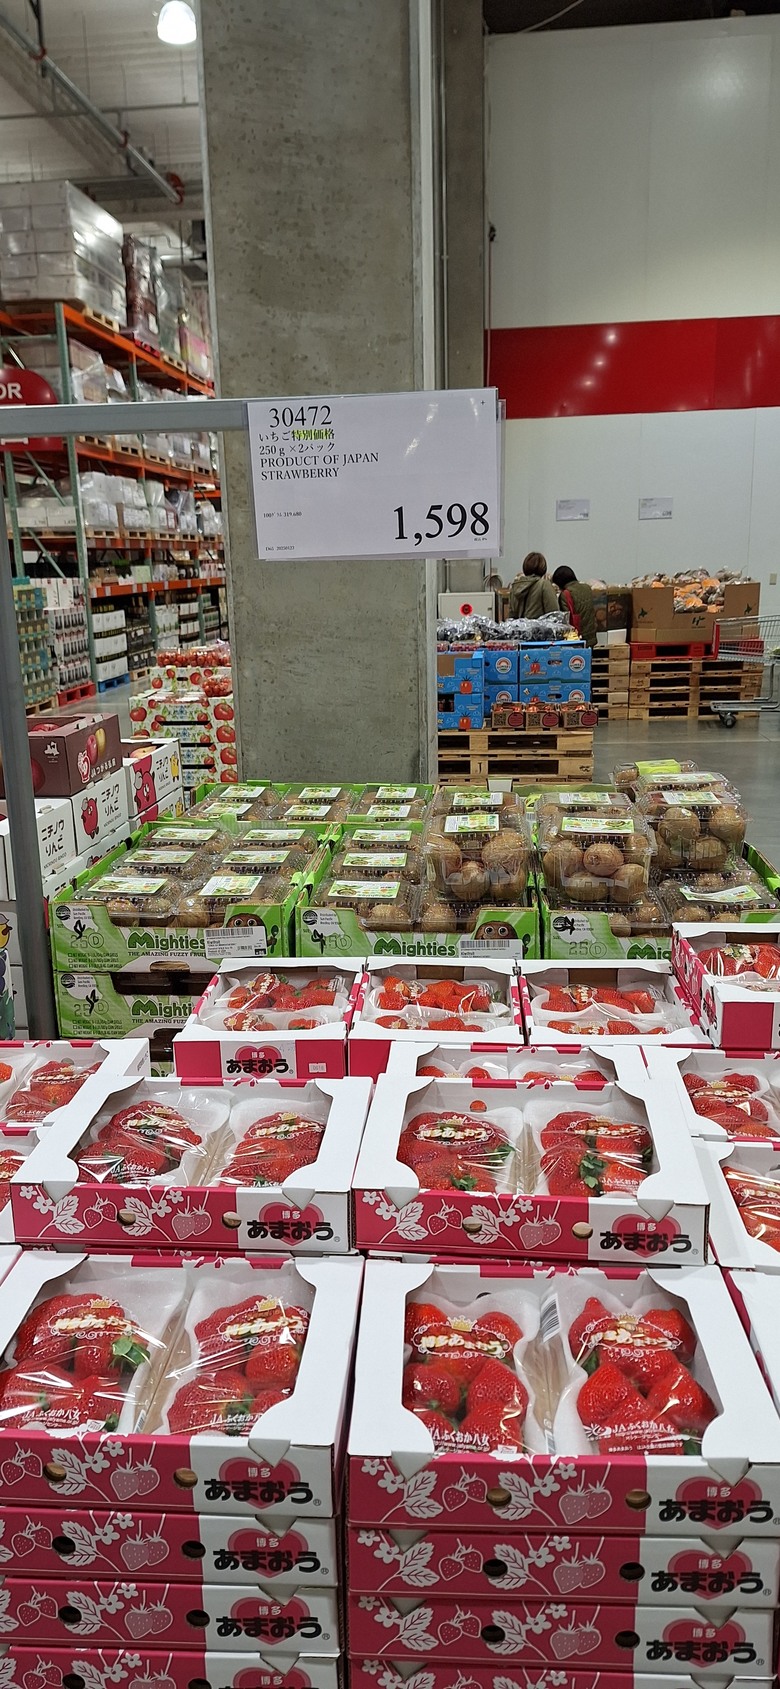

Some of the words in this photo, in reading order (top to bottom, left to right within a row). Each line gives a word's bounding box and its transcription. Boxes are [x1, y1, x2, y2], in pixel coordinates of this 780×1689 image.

[268, 405, 332, 428] 30472
[260, 428, 335, 441] いちご特別価格
[260, 445, 276, 456] 250
[260, 456, 320, 468] PRODUCT
[322, 454, 340, 465] OF
[342, 452, 378, 466] JAPAN
[261, 468, 340, 480] STRAWBERRY
[394, 502, 490, 546] 1,598
[101, 784, 120, 804] ニチノウ
[104, 799, 119, 816] りんご
[41, 819, 65, 842] ニチノウ
[45, 834, 64, 856] りんご
[128, 932, 205, 950] Mighties
[374, 938, 456, 957] Mighties
[226, 1058, 289, 1074] あまおう
[282, 1210, 302, 1219] 博多
[247, 1219, 334, 1241] あまおう
[636, 1222, 656, 1232] 博多
[600, 1231, 692, 1252] あまおう
[248, 1467, 271, 1478] 博多
[204, 1479, 313, 1504] あまおう
[706, 1486, 732, 1497] 博多
[658, 1499, 774, 1523] あまおう
[257, 1537, 280, 1548] 博多
[213, 1549, 320, 1572] あまおう
[698, 1559, 722, 1569] 博多
[651, 1570, 764, 1594] あまおう
[259, 1605, 282, 1616] 博多
[216, 1616, 322, 1638] あまおう
[692, 1628, 716, 1638] 博多
[646, 1640, 756, 1663] あまおう
[260, 1676, 283, 1686] 博多
